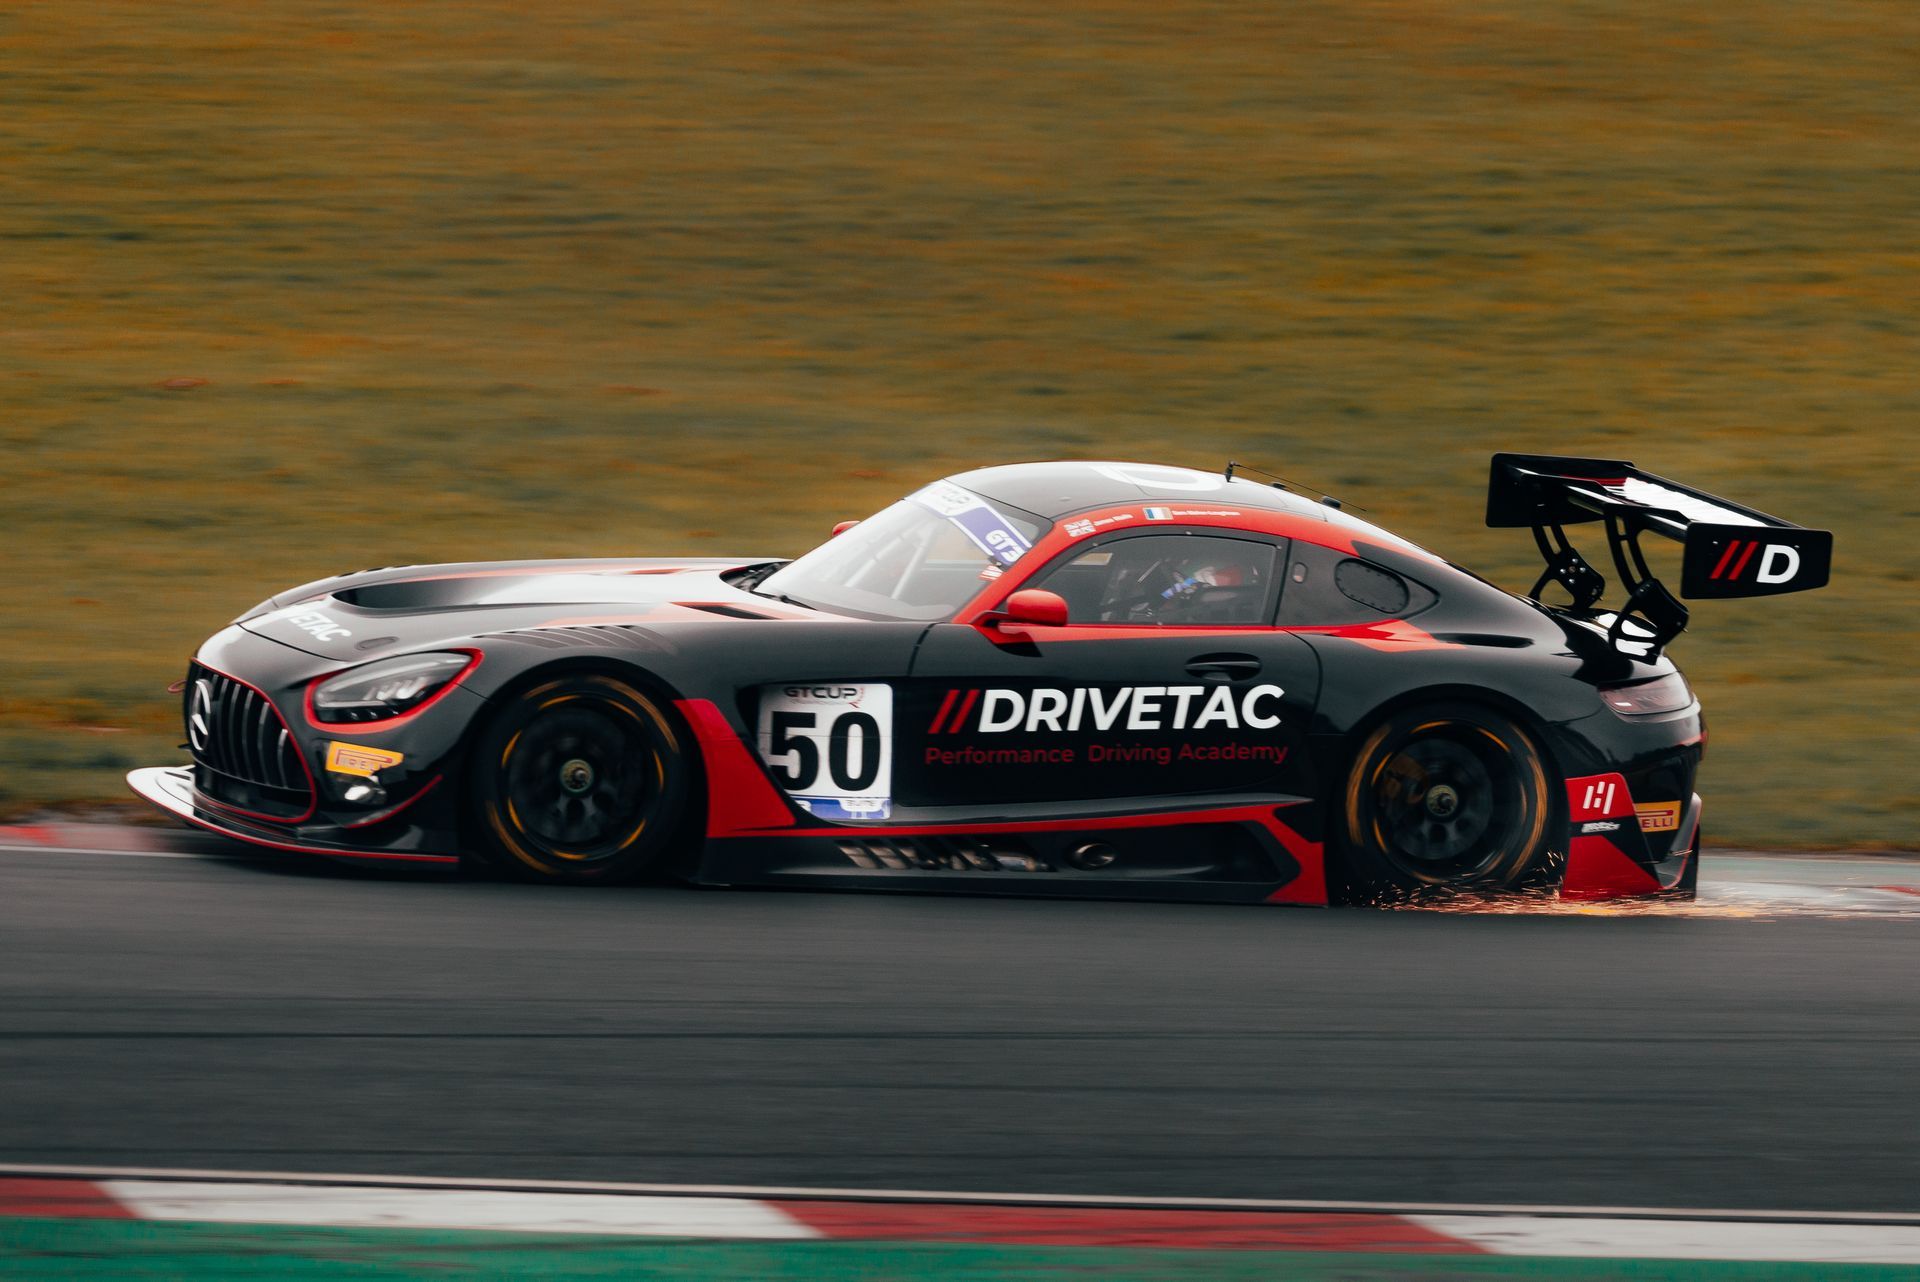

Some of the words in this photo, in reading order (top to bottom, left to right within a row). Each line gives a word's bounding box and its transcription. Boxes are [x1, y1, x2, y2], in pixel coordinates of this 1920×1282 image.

[768, 711, 881, 792] 50
[925, 746, 1075, 765] Performance
[1088, 744, 1171, 766] Driving
[1178, 742, 1288, 764] Academy
